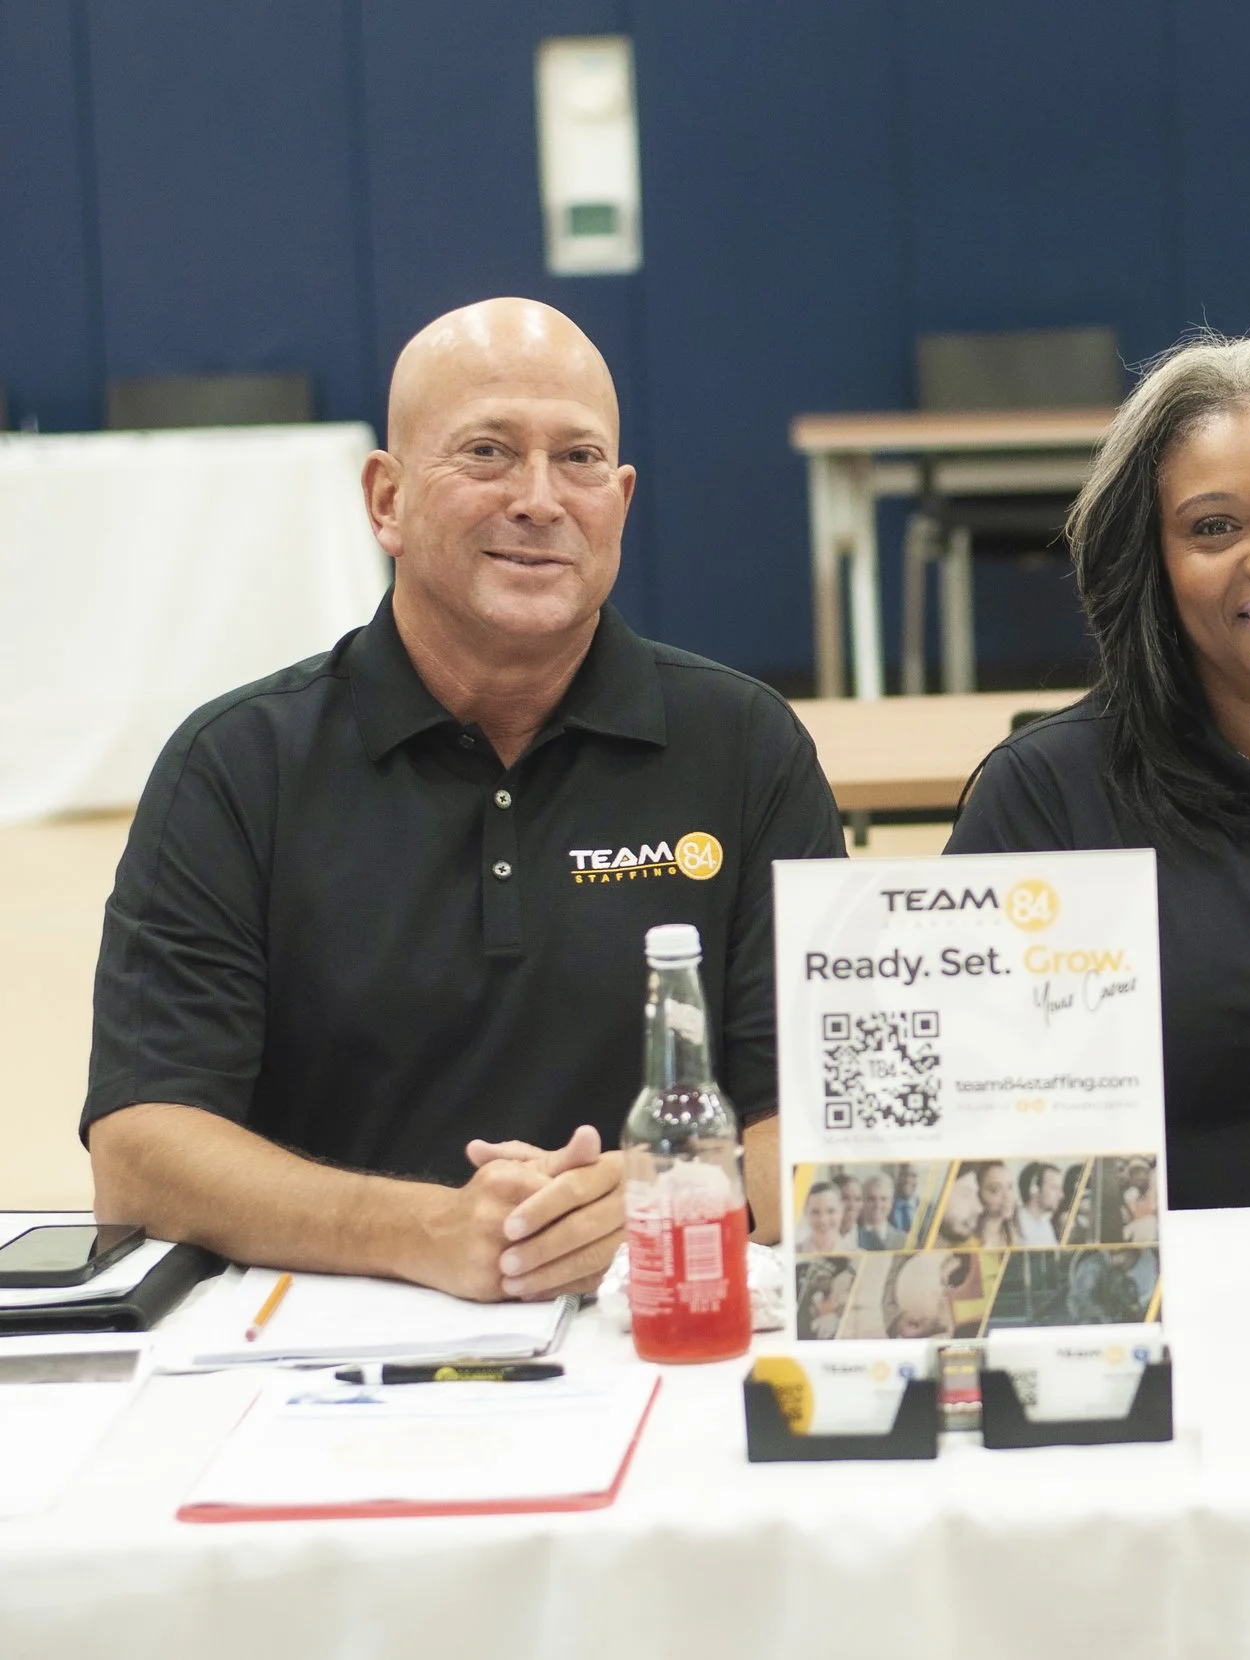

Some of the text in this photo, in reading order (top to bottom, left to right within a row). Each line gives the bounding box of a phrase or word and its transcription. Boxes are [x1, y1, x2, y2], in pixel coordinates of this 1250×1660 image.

[568, 841, 716, 870] TEAM 84
[574, 867, 677, 884] STAFFING
[880, 886, 1051, 923] TEAM 84
[804, 944, 1133, 986] Ready. Set. Grow.
[954, 1072, 1141, 1093] team84staffing.com
